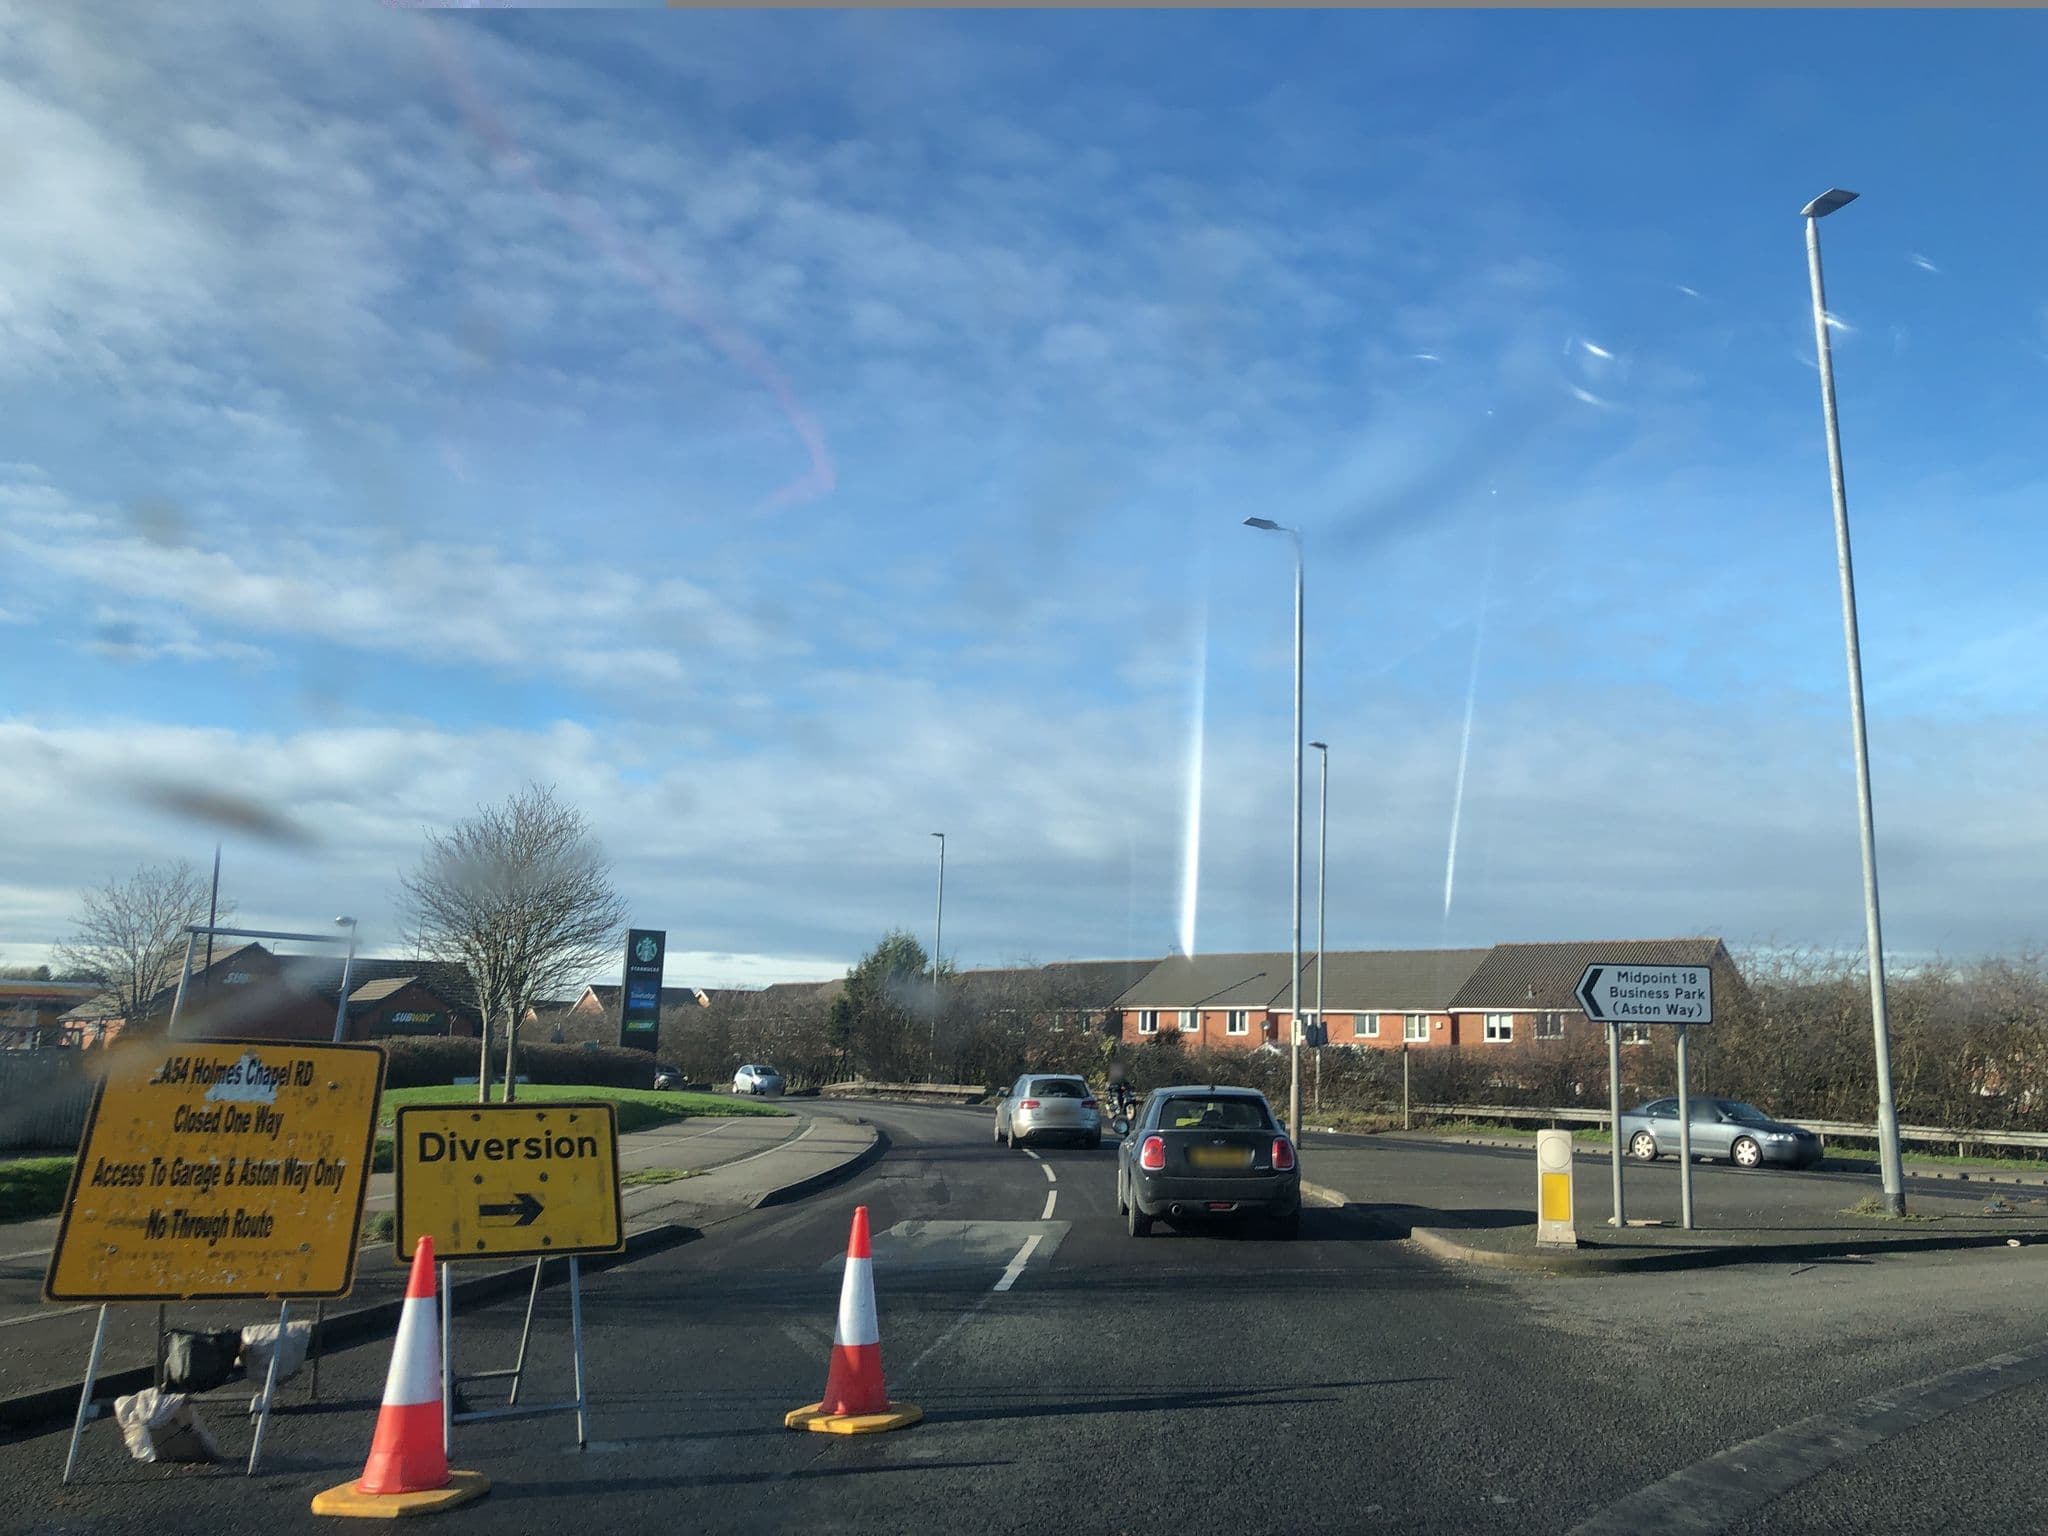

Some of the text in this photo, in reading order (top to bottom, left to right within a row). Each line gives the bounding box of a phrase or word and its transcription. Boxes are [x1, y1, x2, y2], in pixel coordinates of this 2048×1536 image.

[1609, 986, 1706, 1000] Business Park
[1617, 971, 1698, 985] Midpoint 18
[392, 1012, 435, 1022] SUBWAY
[1613, 1001, 1703, 1018] (Aston Way)
[161, 1057, 314, 1092] A54 Holmes Chapel RD
[174, 1104, 285, 1140] Closed One Way
[418, 1129, 598, 1162] Diversion
[91, 1157, 346, 1194] Access To Garage & Aston Way Only
[145, 1208, 275, 1247] No Through Route
